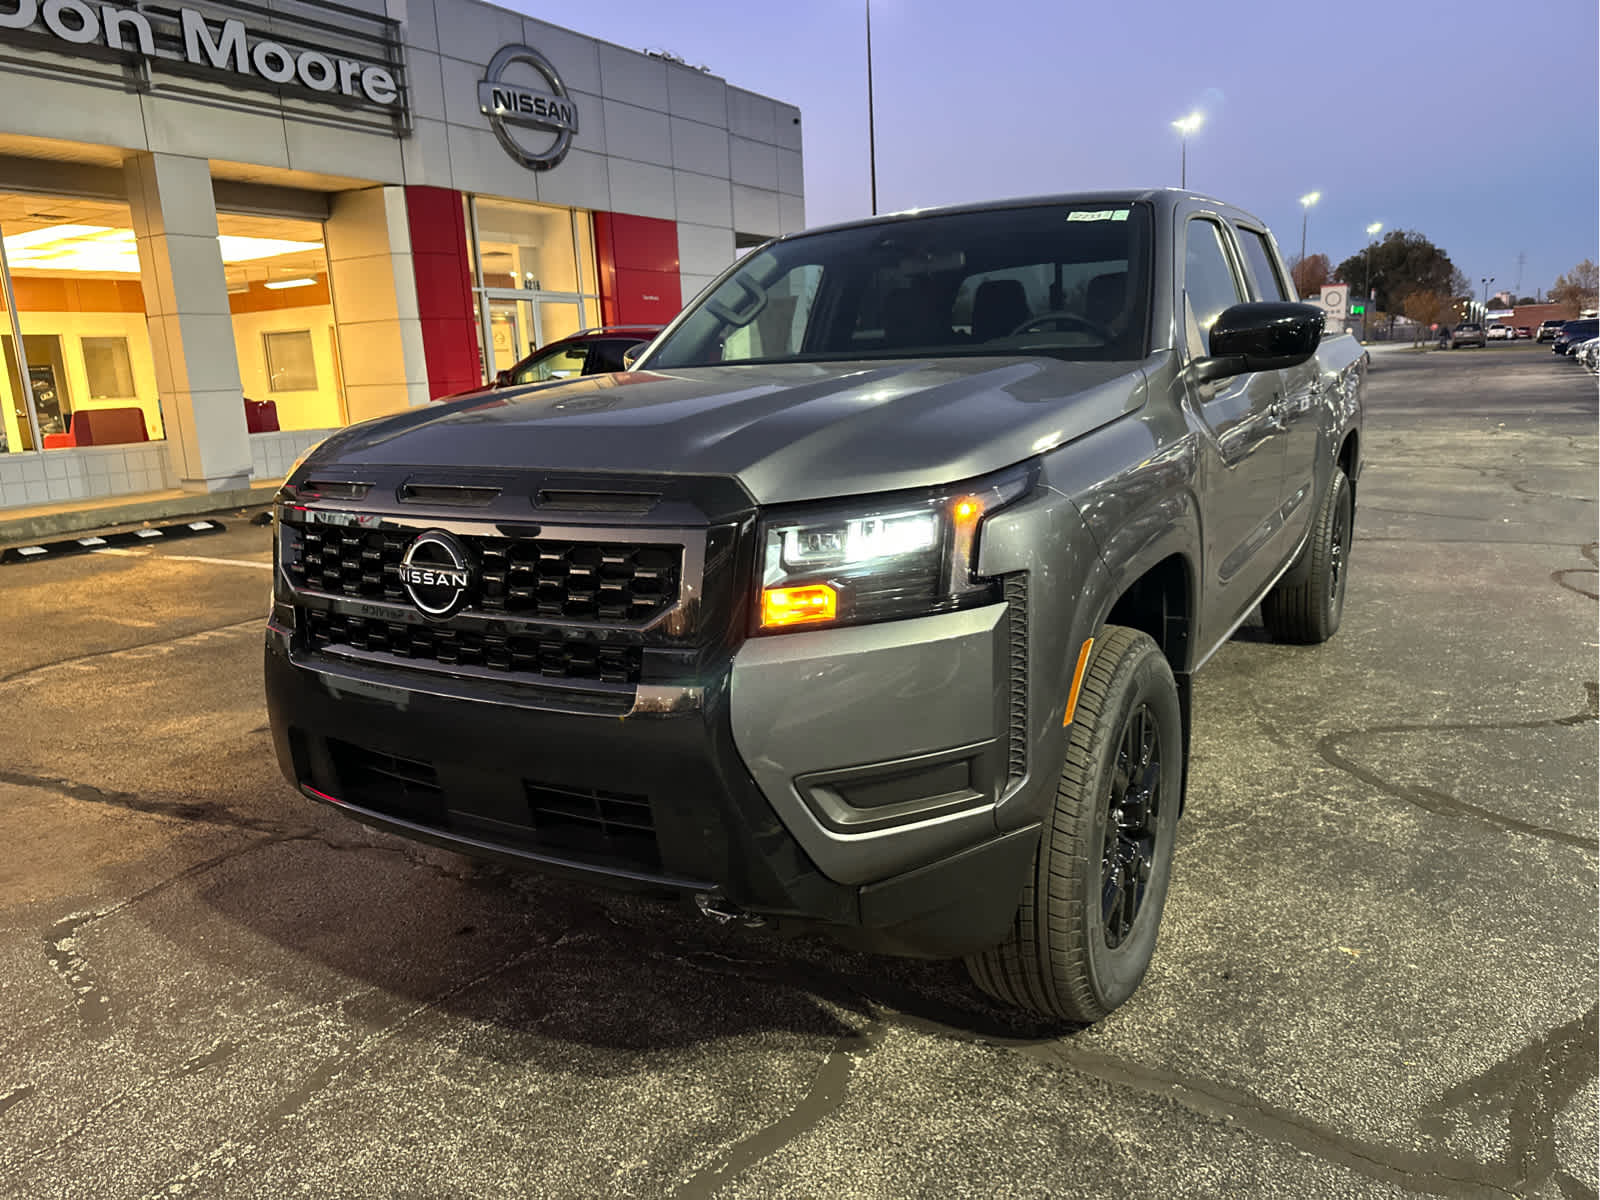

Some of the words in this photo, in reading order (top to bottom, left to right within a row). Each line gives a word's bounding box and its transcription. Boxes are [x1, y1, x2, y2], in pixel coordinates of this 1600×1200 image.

[0, 0, 155, 56] on
[181, 7, 398, 104] Moore
[492, 88, 571, 126] NISSAN
[399, 568, 467, 586] NISSAN
